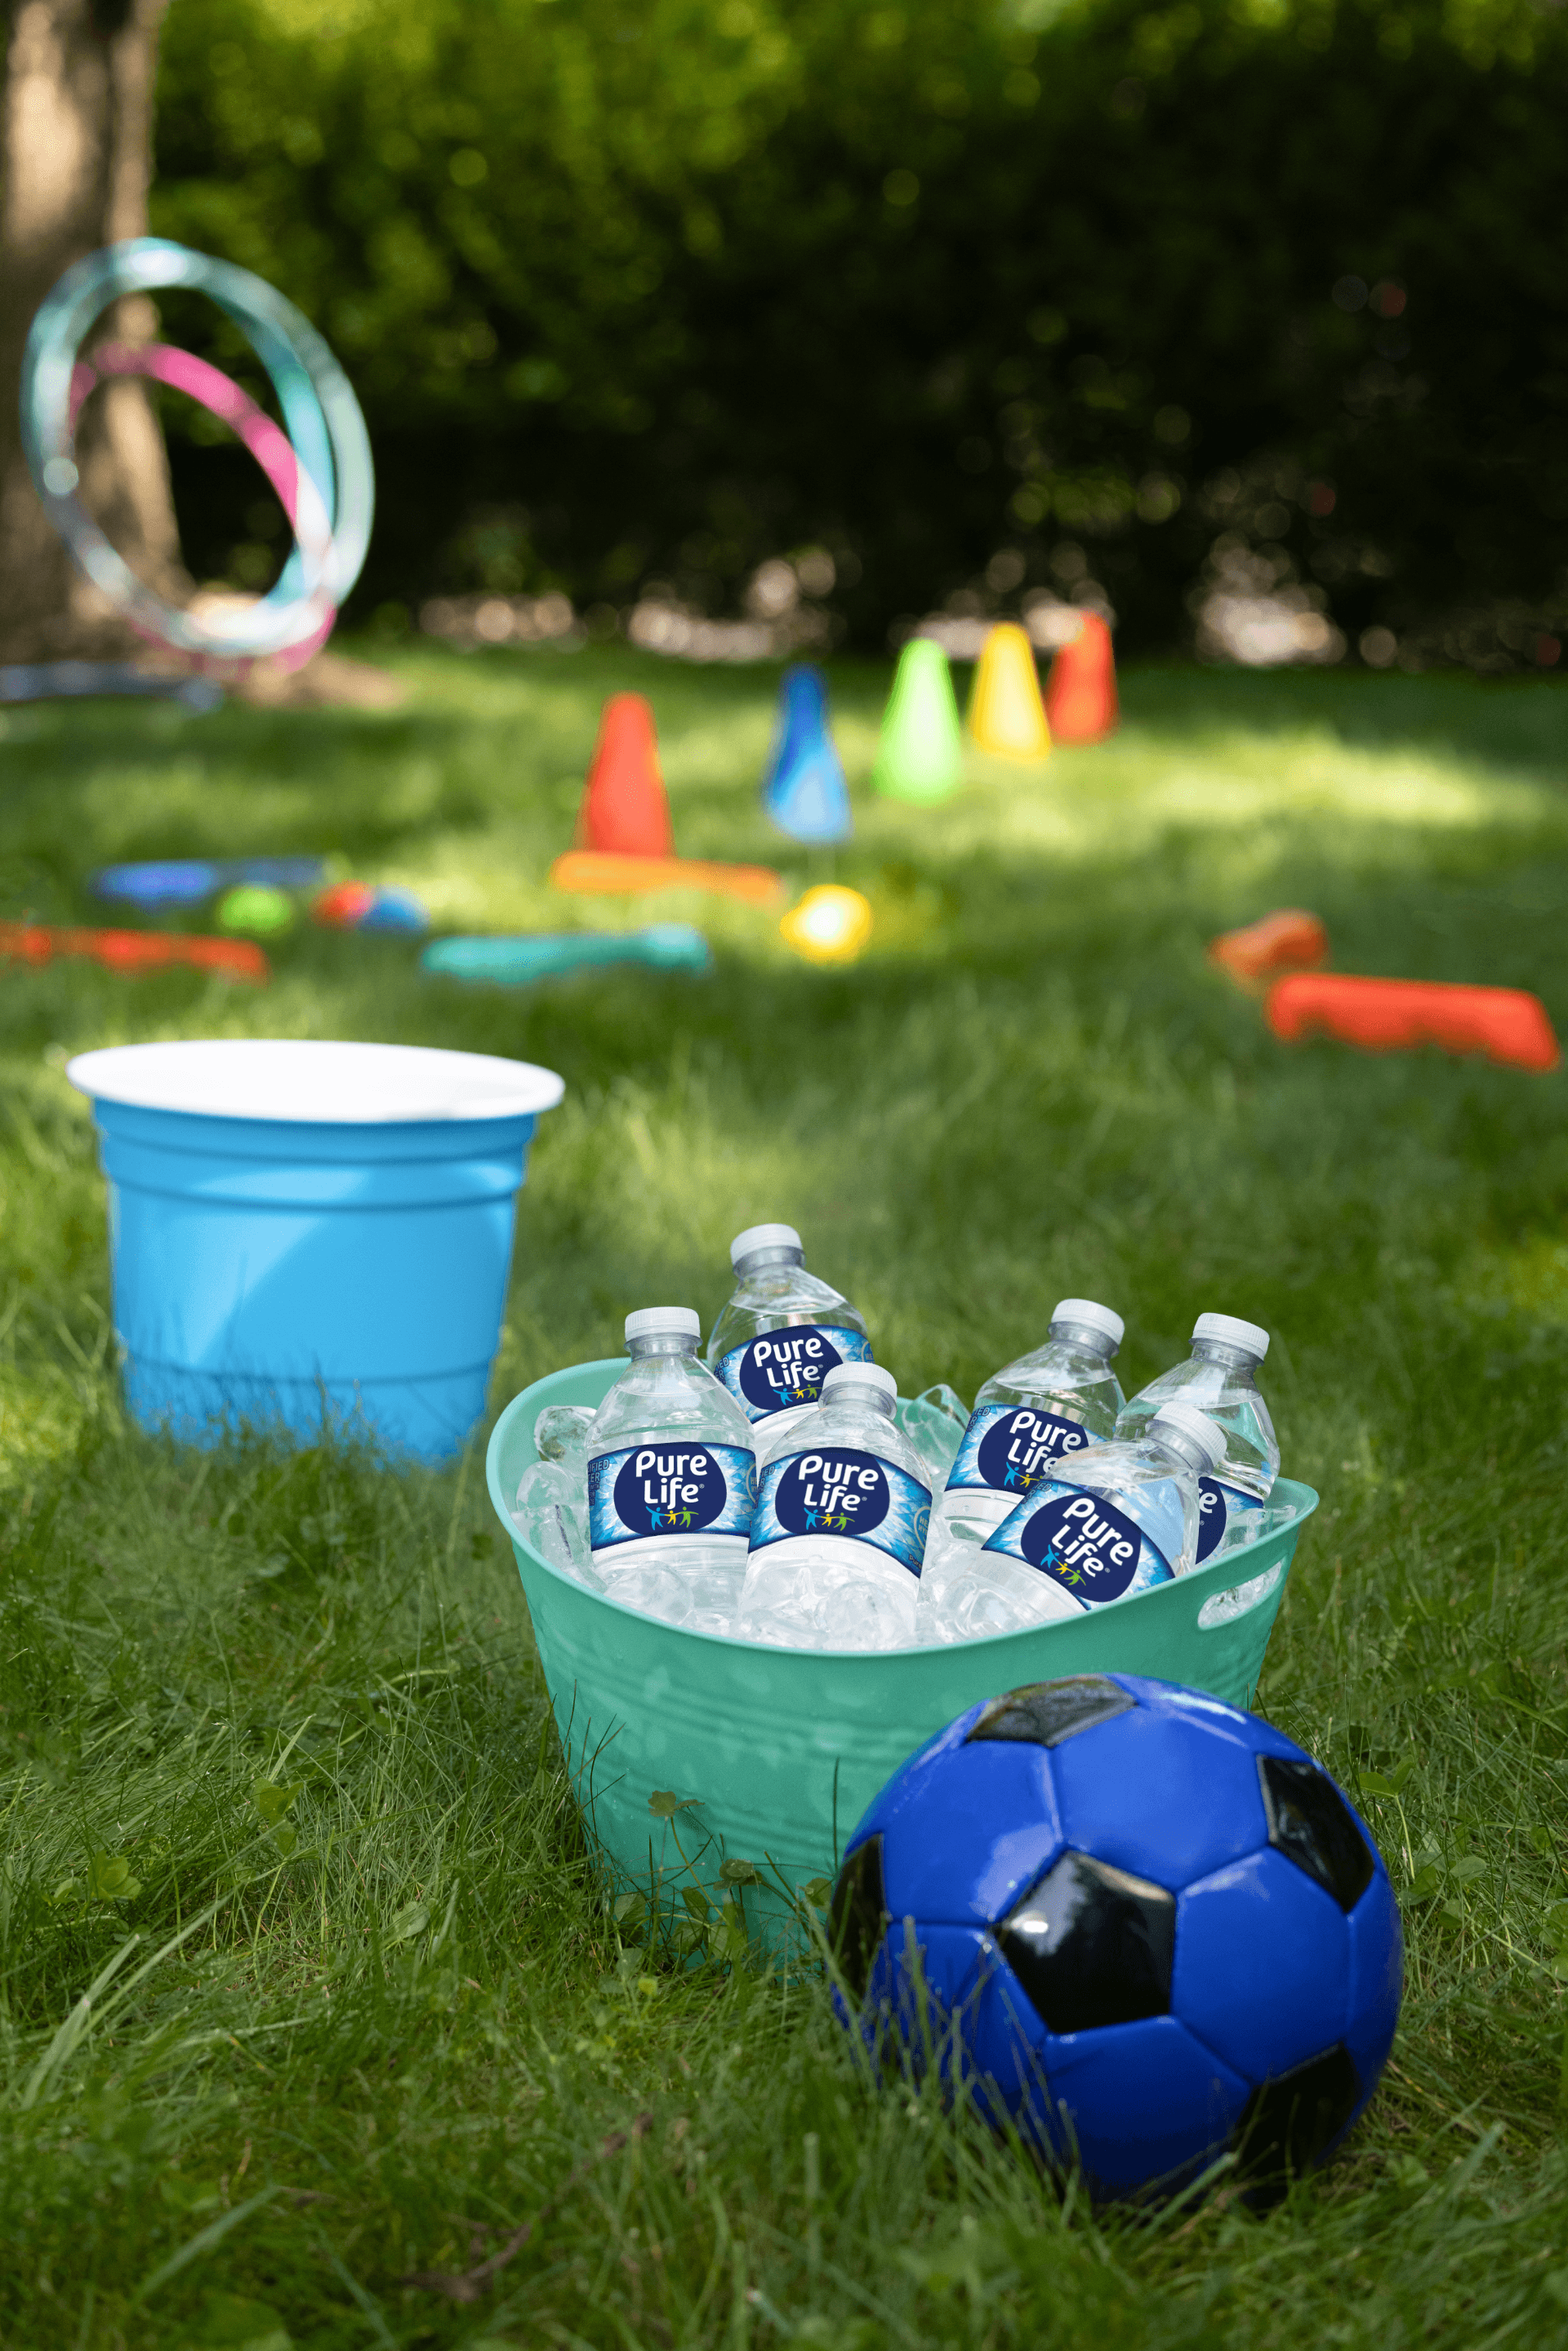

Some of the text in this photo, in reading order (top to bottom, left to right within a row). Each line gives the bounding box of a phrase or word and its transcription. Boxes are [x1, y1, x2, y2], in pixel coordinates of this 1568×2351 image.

[753, 1338, 824, 1368] Pure
[767, 1363, 821, 1389] Life
[1009, 1411, 1082, 1454] Pure
[635, 1450, 707, 1477] Pure
[798, 1455, 879, 1490] Pure
[644, 1477, 699, 1510] Life
[804, 1484, 861, 1513] Life
[1062, 1498, 1134, 1566] Pure
[1051, 1524, 1104, 1578] Life
